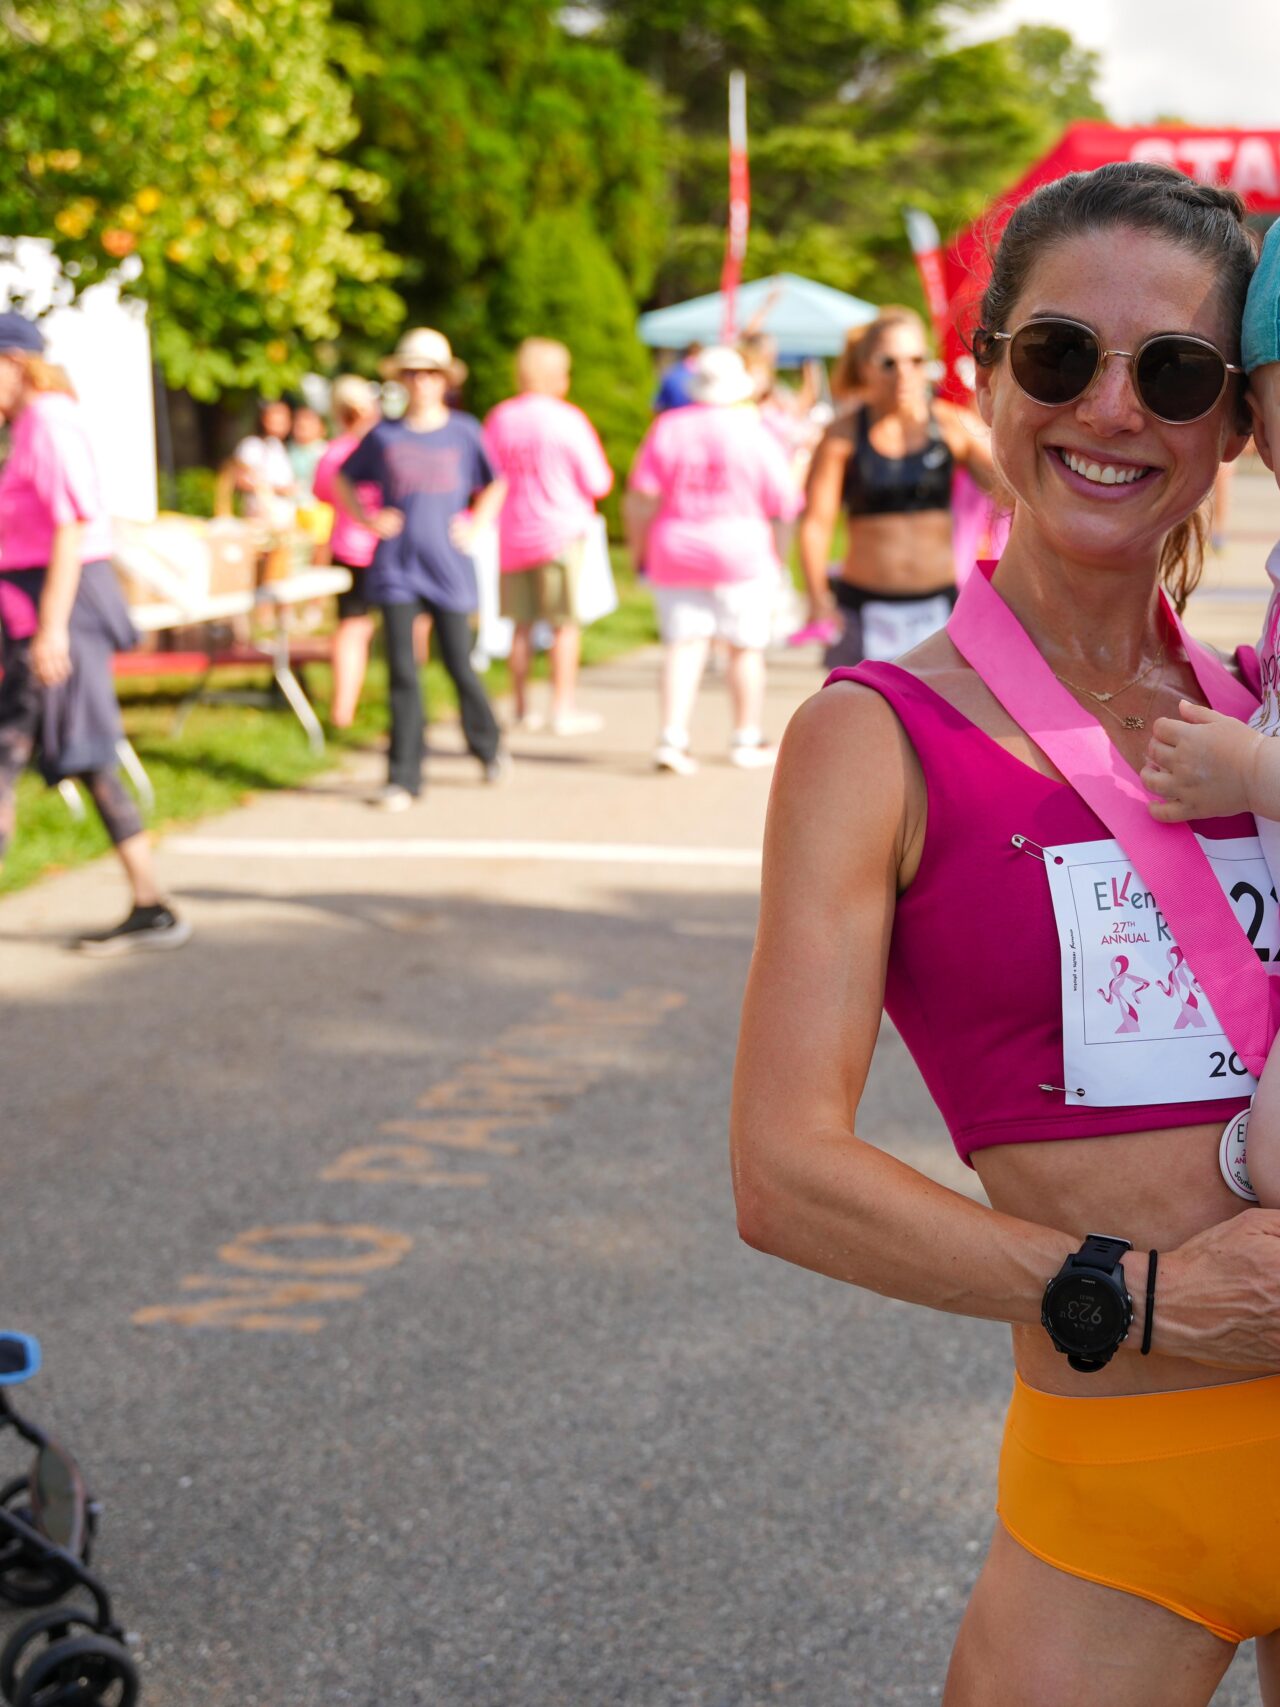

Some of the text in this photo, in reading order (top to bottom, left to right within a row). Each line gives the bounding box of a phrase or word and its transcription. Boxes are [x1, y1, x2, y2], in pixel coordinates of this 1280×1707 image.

[1101, 932, 1151, 945] ANNUAL
[130, 984, 690, 1336] NO PARK
